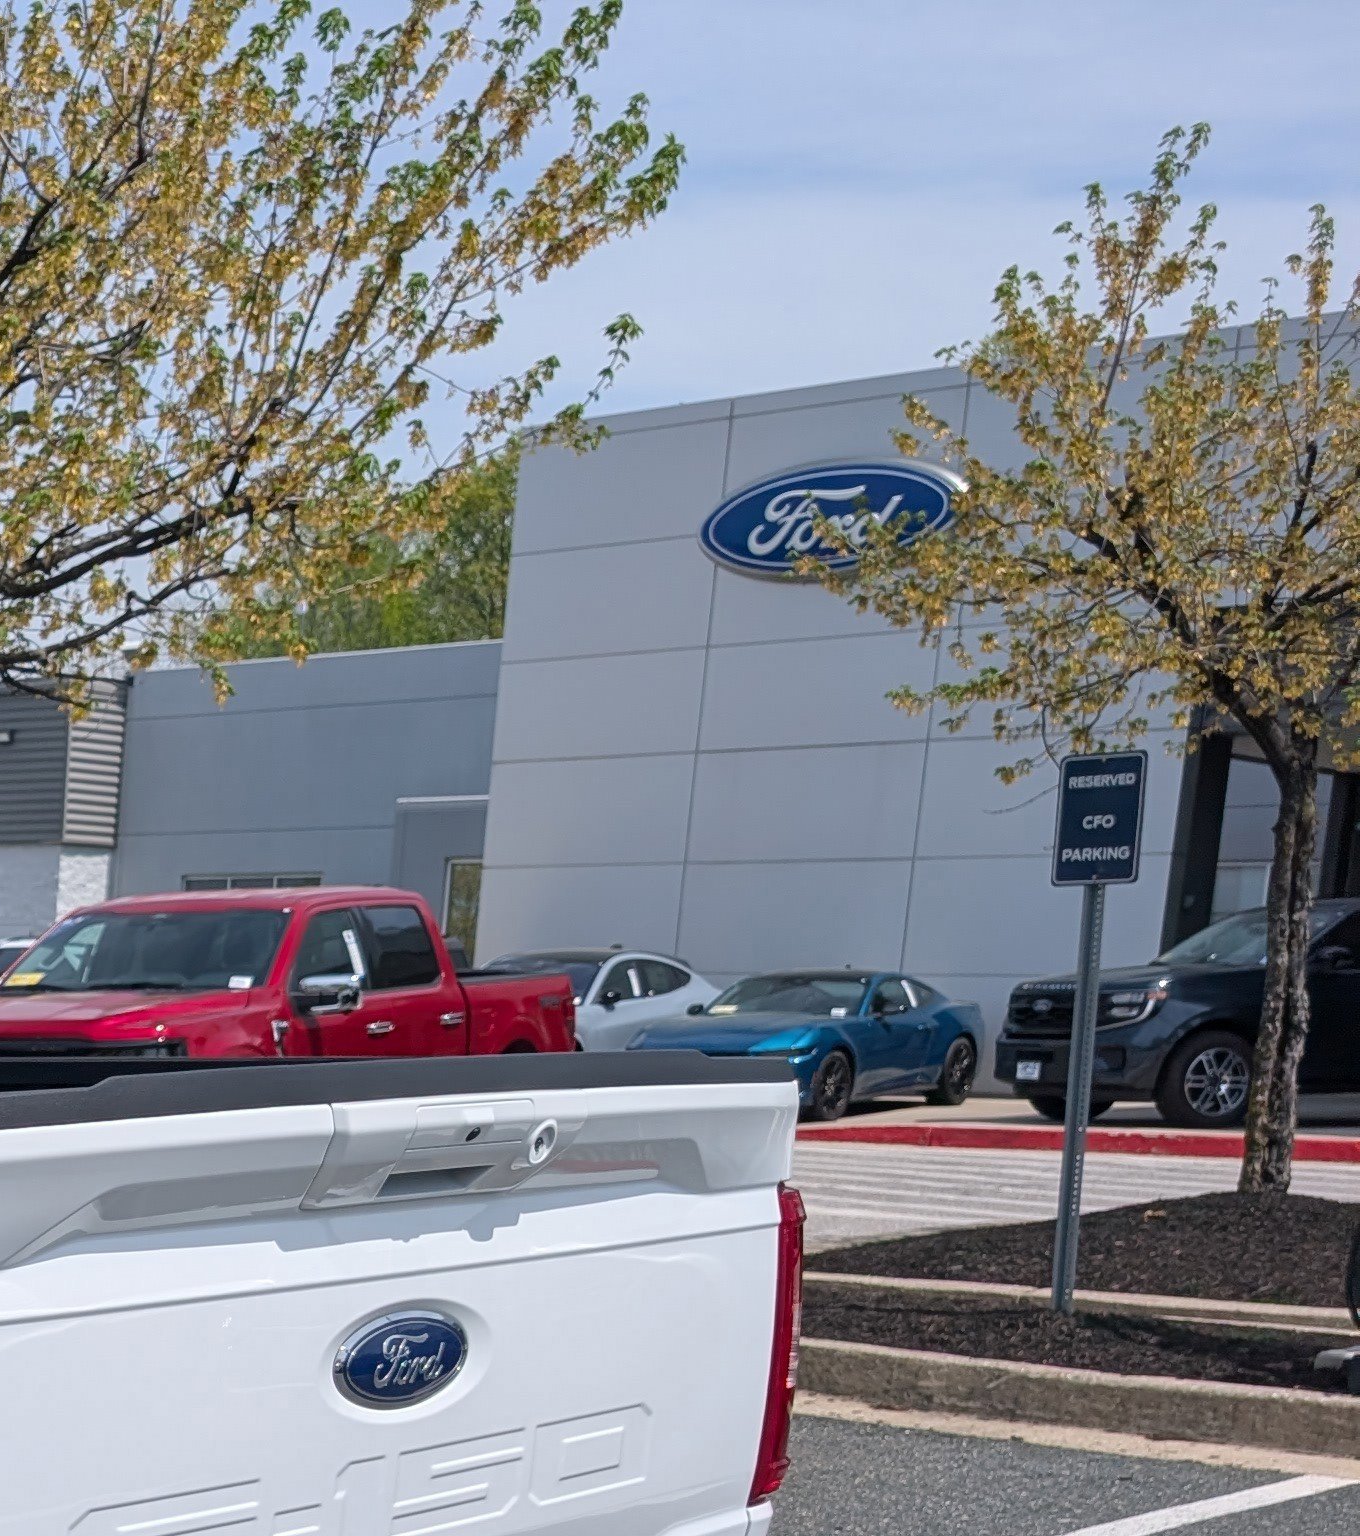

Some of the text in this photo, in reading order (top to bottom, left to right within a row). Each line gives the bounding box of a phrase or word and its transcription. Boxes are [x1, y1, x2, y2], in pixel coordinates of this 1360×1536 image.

[1068, 772, 1137, 790] RESERVED
[1081, 813, 1116, 831] CFO
[1061, 845, 1132, 863] PARKING
[373, 1332, 446, 1389] Ford
